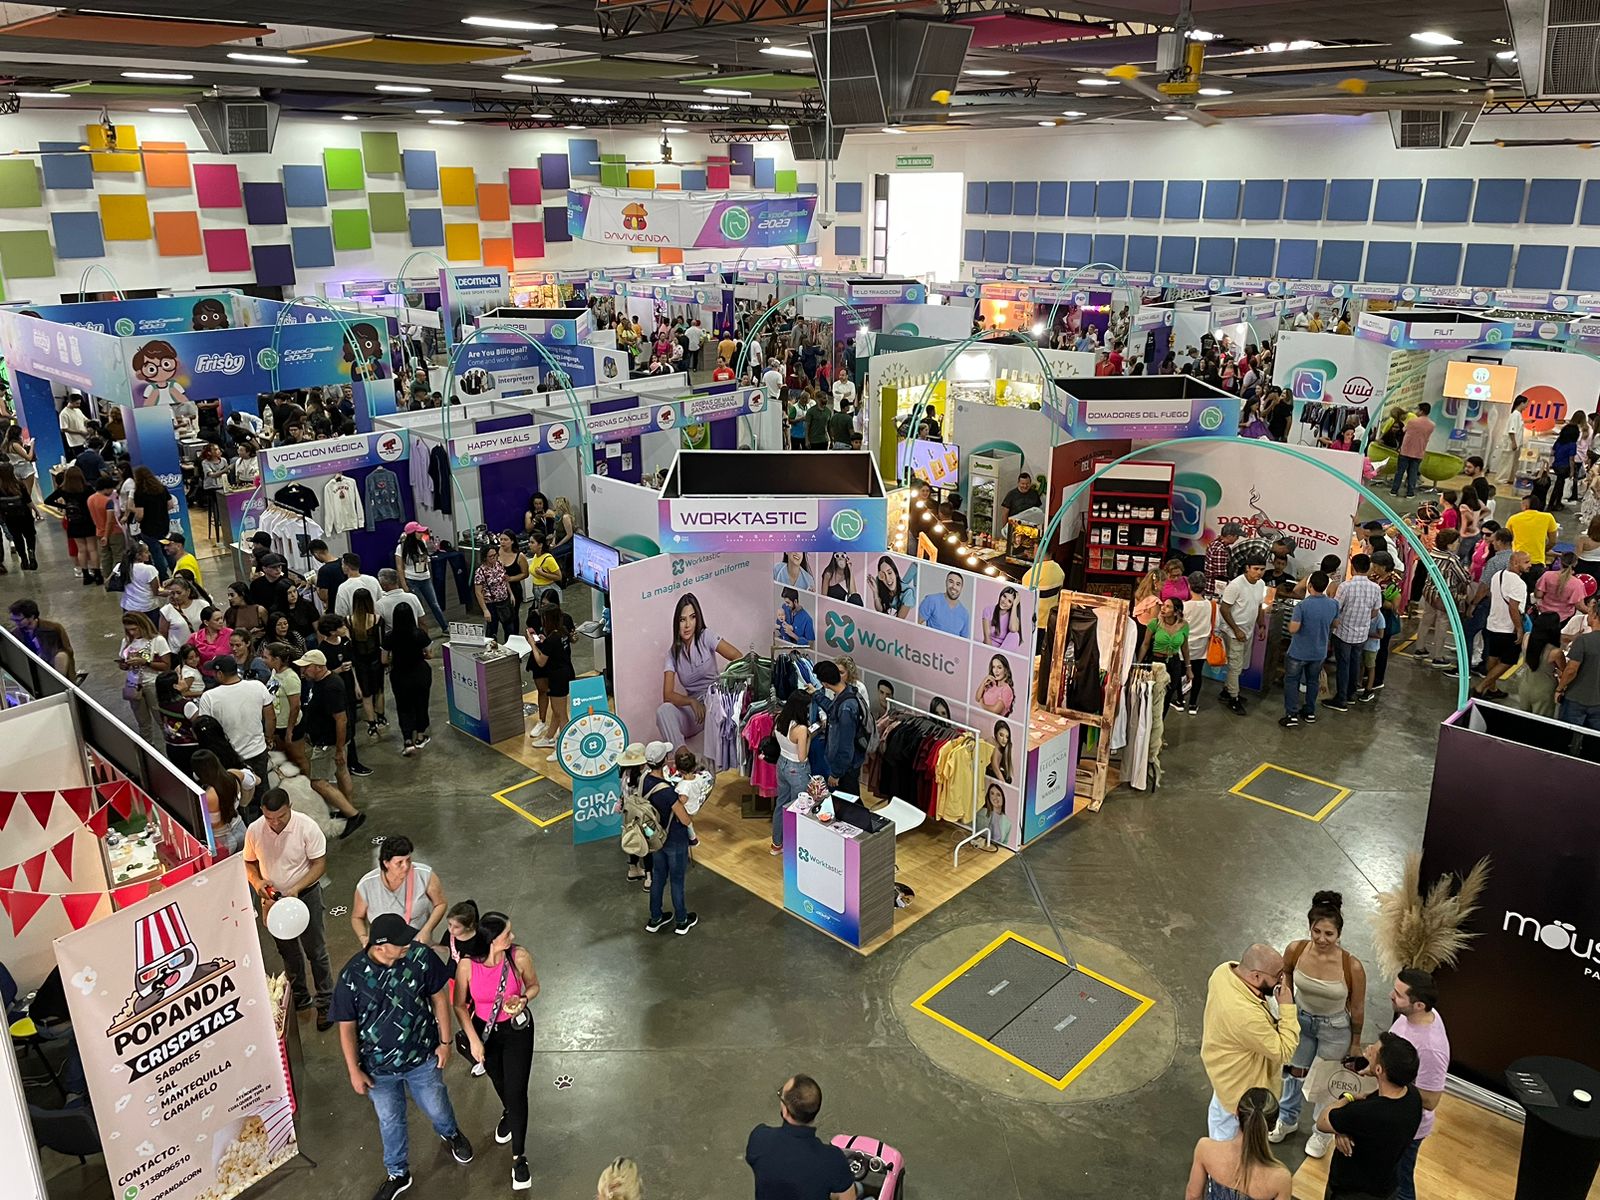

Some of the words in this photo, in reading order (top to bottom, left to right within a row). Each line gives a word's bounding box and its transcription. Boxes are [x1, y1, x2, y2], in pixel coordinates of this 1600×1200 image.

[757, 218, 791, 229] 2023
[604, 231, 671, 243] DAVIVIENDA
[458, 276, 499, 287] DECATHLON
[1433, 328, 1455, 336] FILIT
[496, 346, 527, 356] Bilingual?
[195, 353, 245, 375] Frisby
[498, 375, 535, 384] Interpreters
[1342, 383, 1375, 397] Wild
[618, 412, 649, 424] CANDLES
[1088, 411, 1141, 420] DOMADORES
[1143, 411, 1159, 419] DEL
[1160, 410, 1189, 419] FUEGO
[328, 441, 364, 455] MÉDICA
[467, 437, 498, 452] HAPPY
[499, 433, 530, 447] MEALS
[680, 511, 807, 526] WORKTASTIC
[1217, 516, 1340, 546] DOMADORES
[684, 552, 722, 569] Worktastic
[641, 588, 652, 600] La
[654, 582, 682, 597] magia
[682, 576, 694, 587] de
[695, 571, 713, 584] usar
[714, 560, 750, 577] uniforme
[857, 627, 955, 676] Worktastic
[577, 790, 618, 809] GIRA
[809, 853, 842, 876] Worktastic
[113, 974, 236, 1057] POPANDA
[135, 1003, 236, 1074] CRISPETAS
[154, 1050, 201, 1085] SABORES
[157, 1080, 178, 1097] SAL
[160, 1060, 232, 1110] MANTEQUILLA
[1331, 1080, 1358, 1092] PERSA
[163, 1081, 218, 1121] CARAMELO
[240, 1096, 261, 1111] EVENTOS
[118, 1144, 180, 1188] CONTACTO:
[139, 1154, 191, 1191] 3138096510
